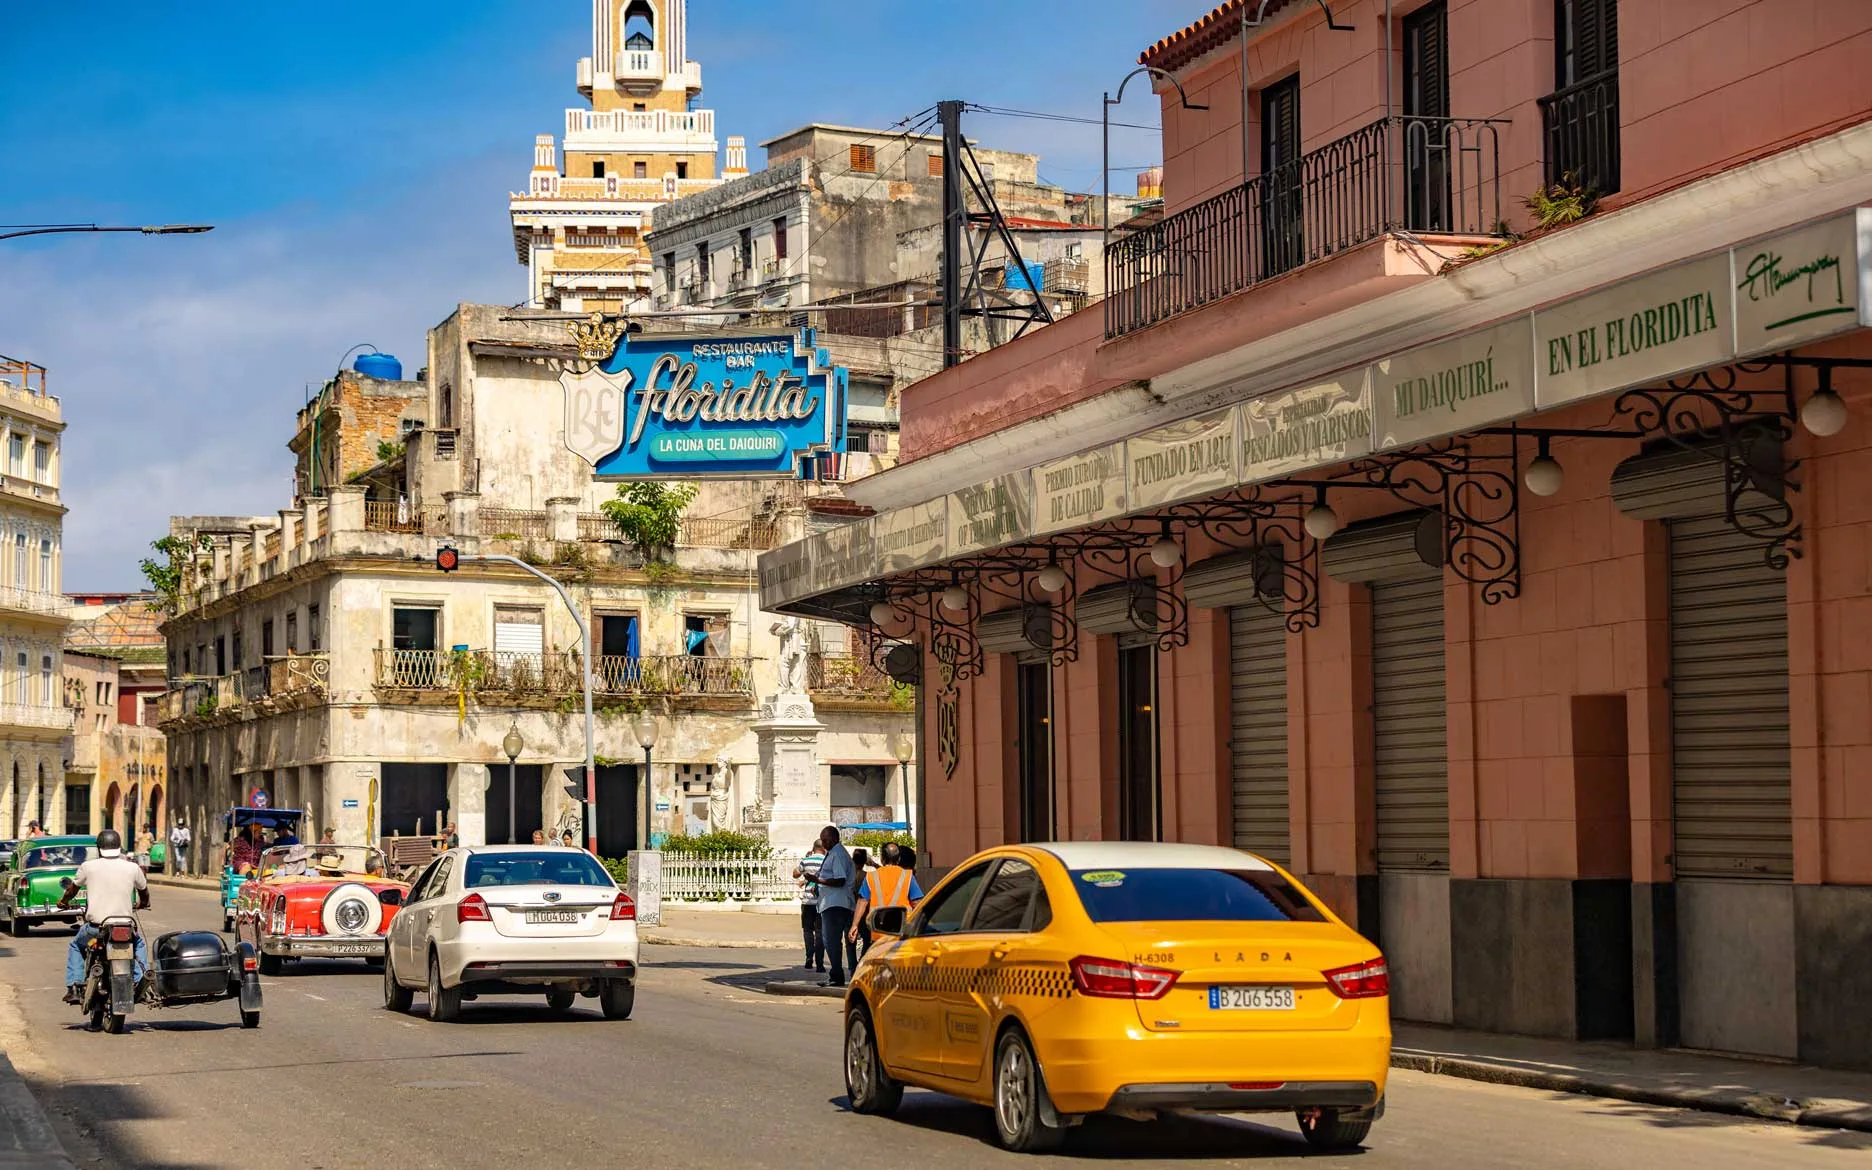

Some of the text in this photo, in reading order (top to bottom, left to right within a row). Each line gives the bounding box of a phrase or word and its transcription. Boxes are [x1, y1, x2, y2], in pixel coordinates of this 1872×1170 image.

[692, 340, 789, 357] RESTAURANTE
[1548, 291, 1717, 376] EN EL FLORIDITA
[726, 355, 755, 368] BAR
[1395, 381, 1414, 418] MI
[659, 437, 776, 452] LA CUNA DEL DAIQUIRI
[1243, 427, 1300, 467] PESCADOS
[1308, 407, 1371, 451] MARISCOS
[1135, 446, 1187, 487] FUNDADO
[1188, 440, 1204, 472] EN
[1045, 467, 1073, 493] PREMIO
[1051, 484, 1104, 522] DE CALIDAD
[1134, 953, 1175, 963] H-6308
